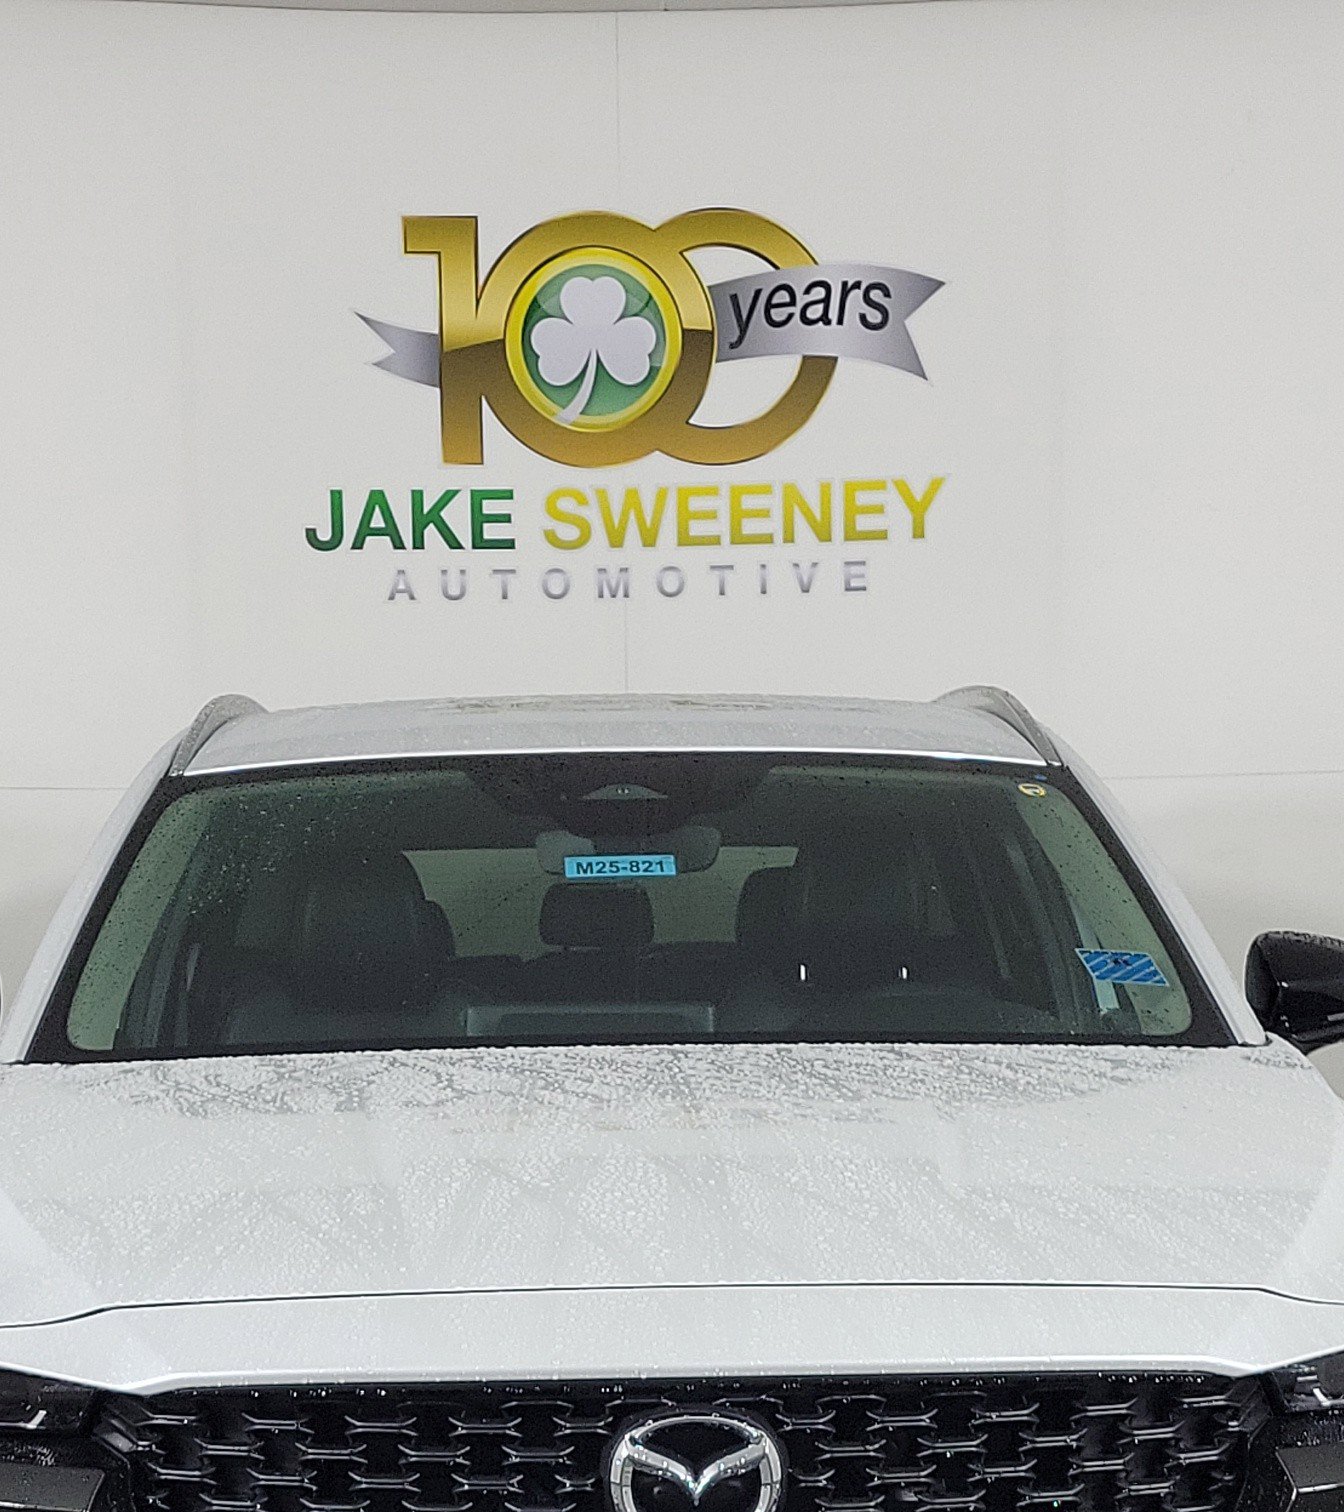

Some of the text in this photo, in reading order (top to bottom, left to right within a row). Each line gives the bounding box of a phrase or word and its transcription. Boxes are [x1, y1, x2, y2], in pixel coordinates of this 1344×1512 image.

[402, 208, 892, 467] 100 years
[305, 477, 944, 551] JAKE SWEENEY
[387, 560, 868, 601] AUTOMOTIVE
[576, 860, 666, 875] M25-821
